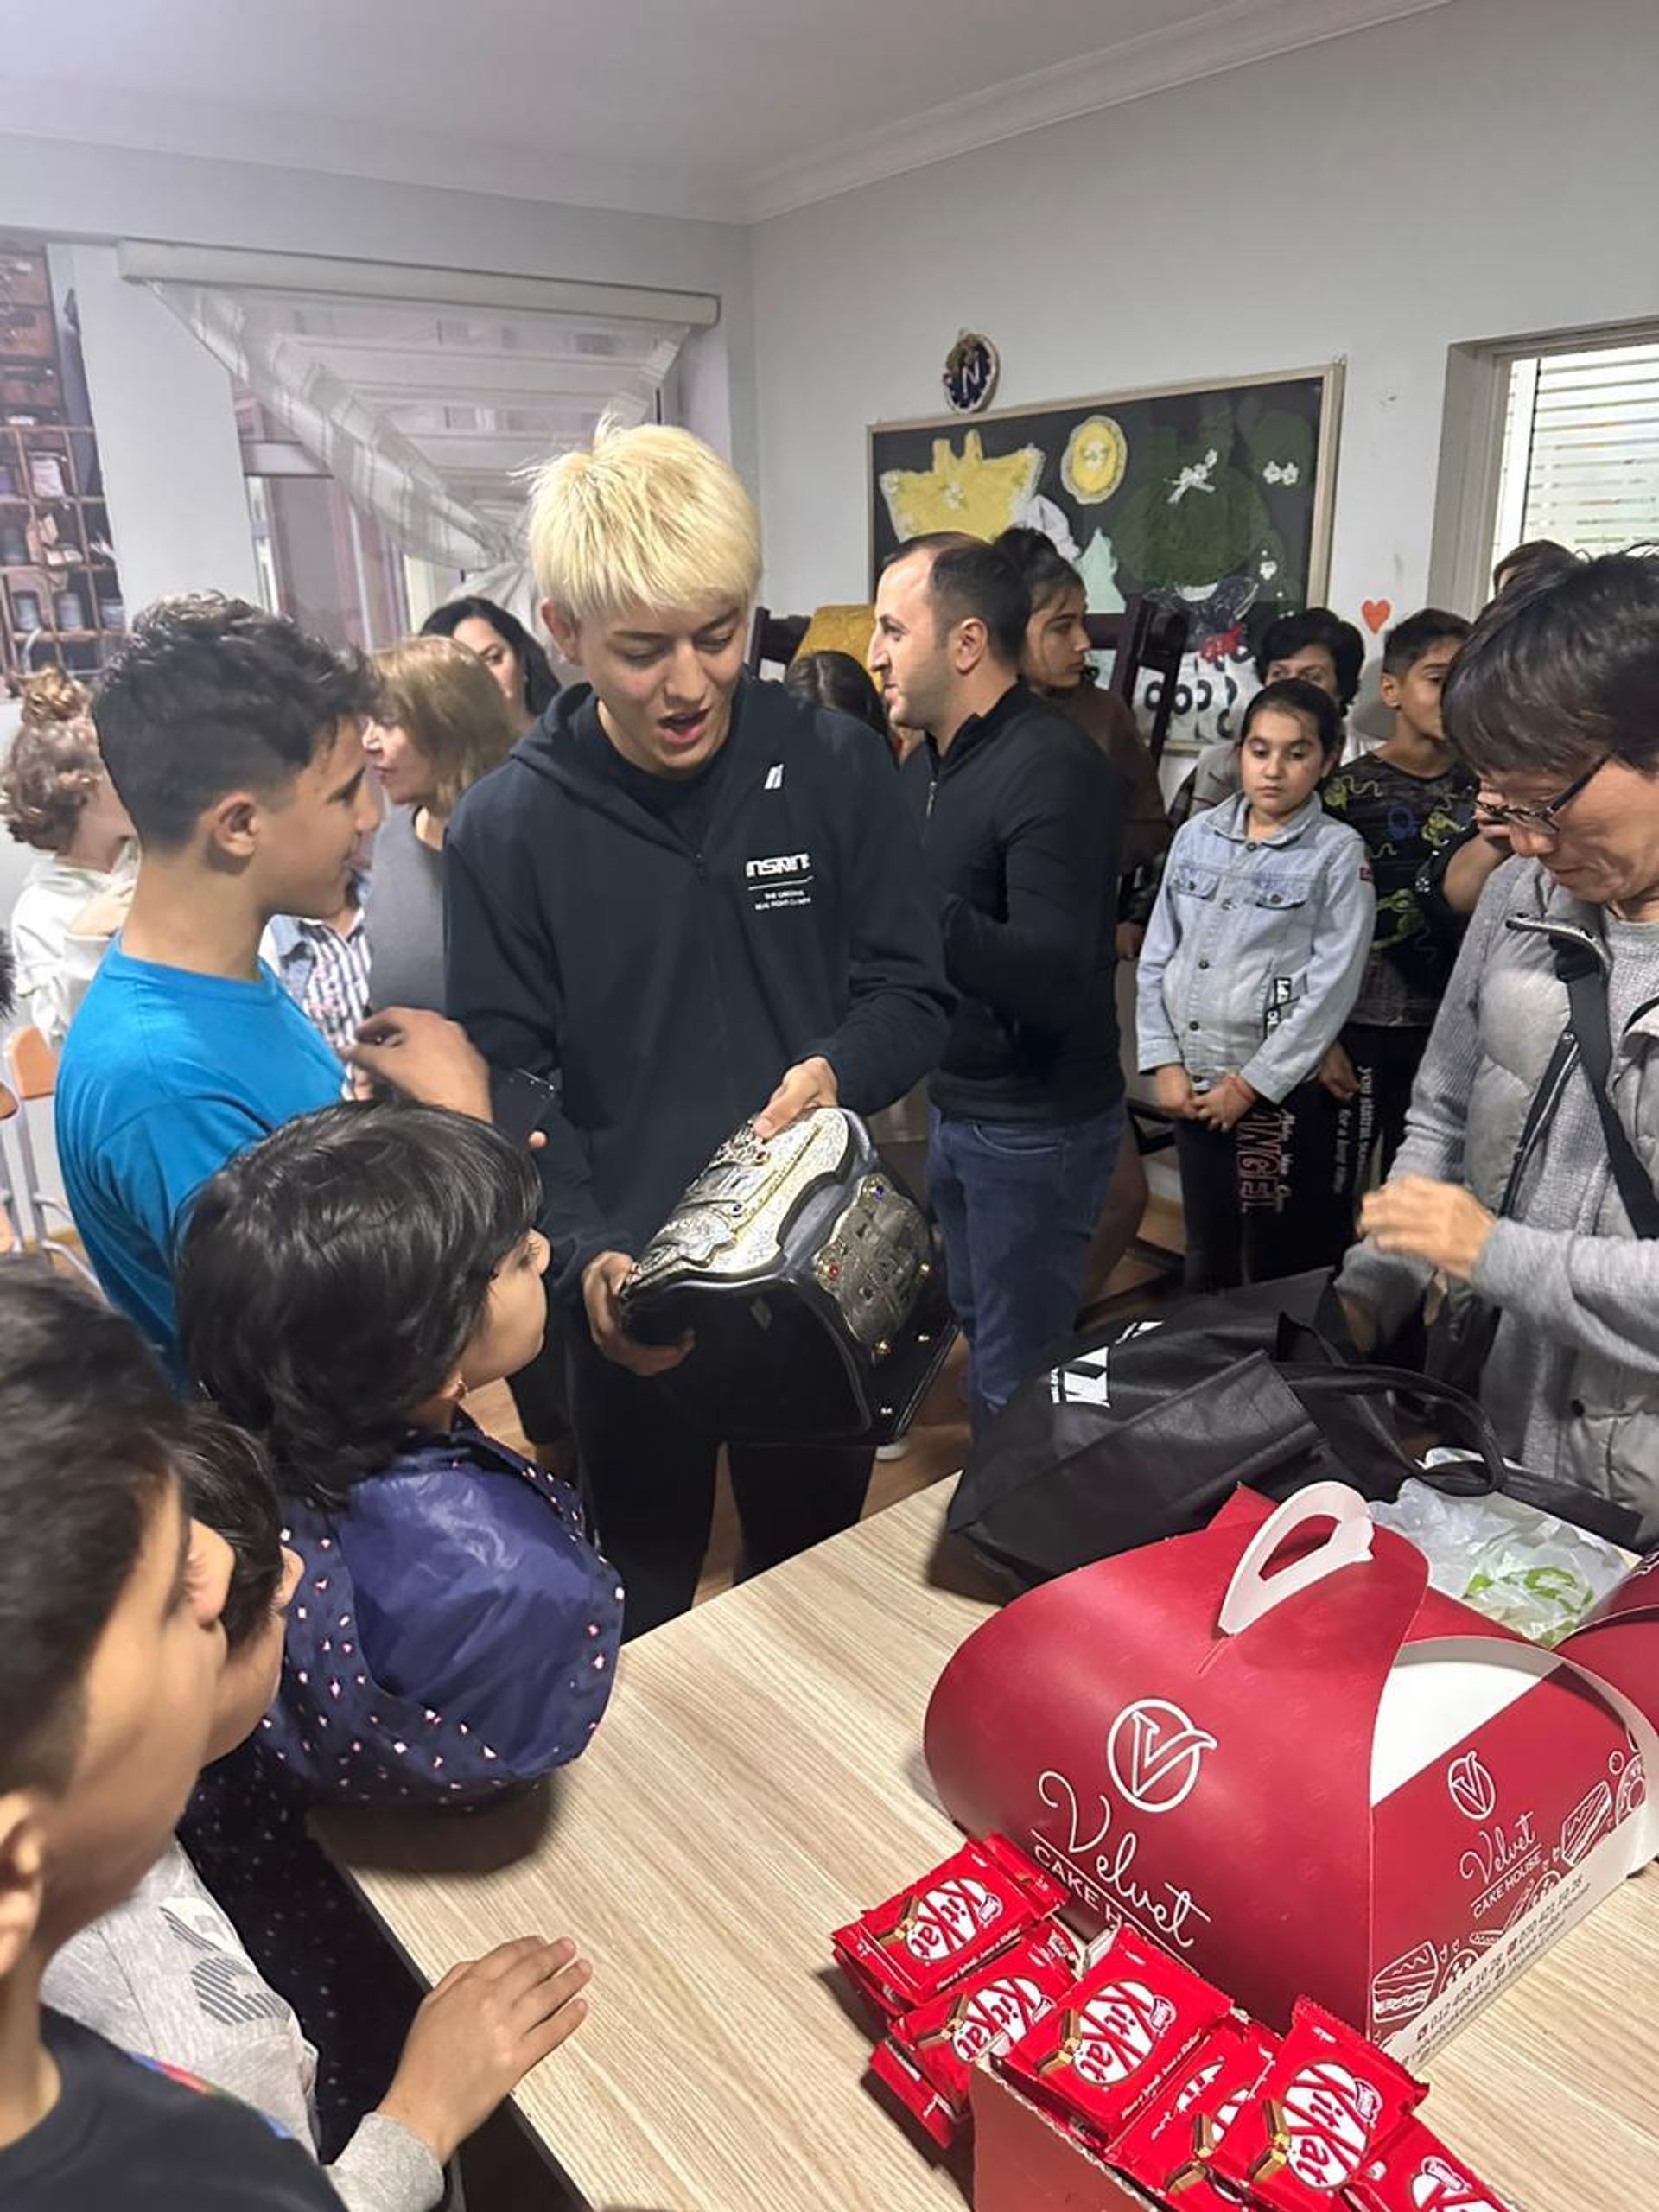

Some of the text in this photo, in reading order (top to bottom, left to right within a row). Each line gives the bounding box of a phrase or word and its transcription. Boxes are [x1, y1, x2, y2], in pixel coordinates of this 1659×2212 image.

[1034, 1844, 1101, 1912] CAKE
[1038, 1770, 1211, 1948] Velvet
[1459, 1811, 1538, 1885] Velvet
[1472, 1852, 1543, 1920] CAKE HOUSE
